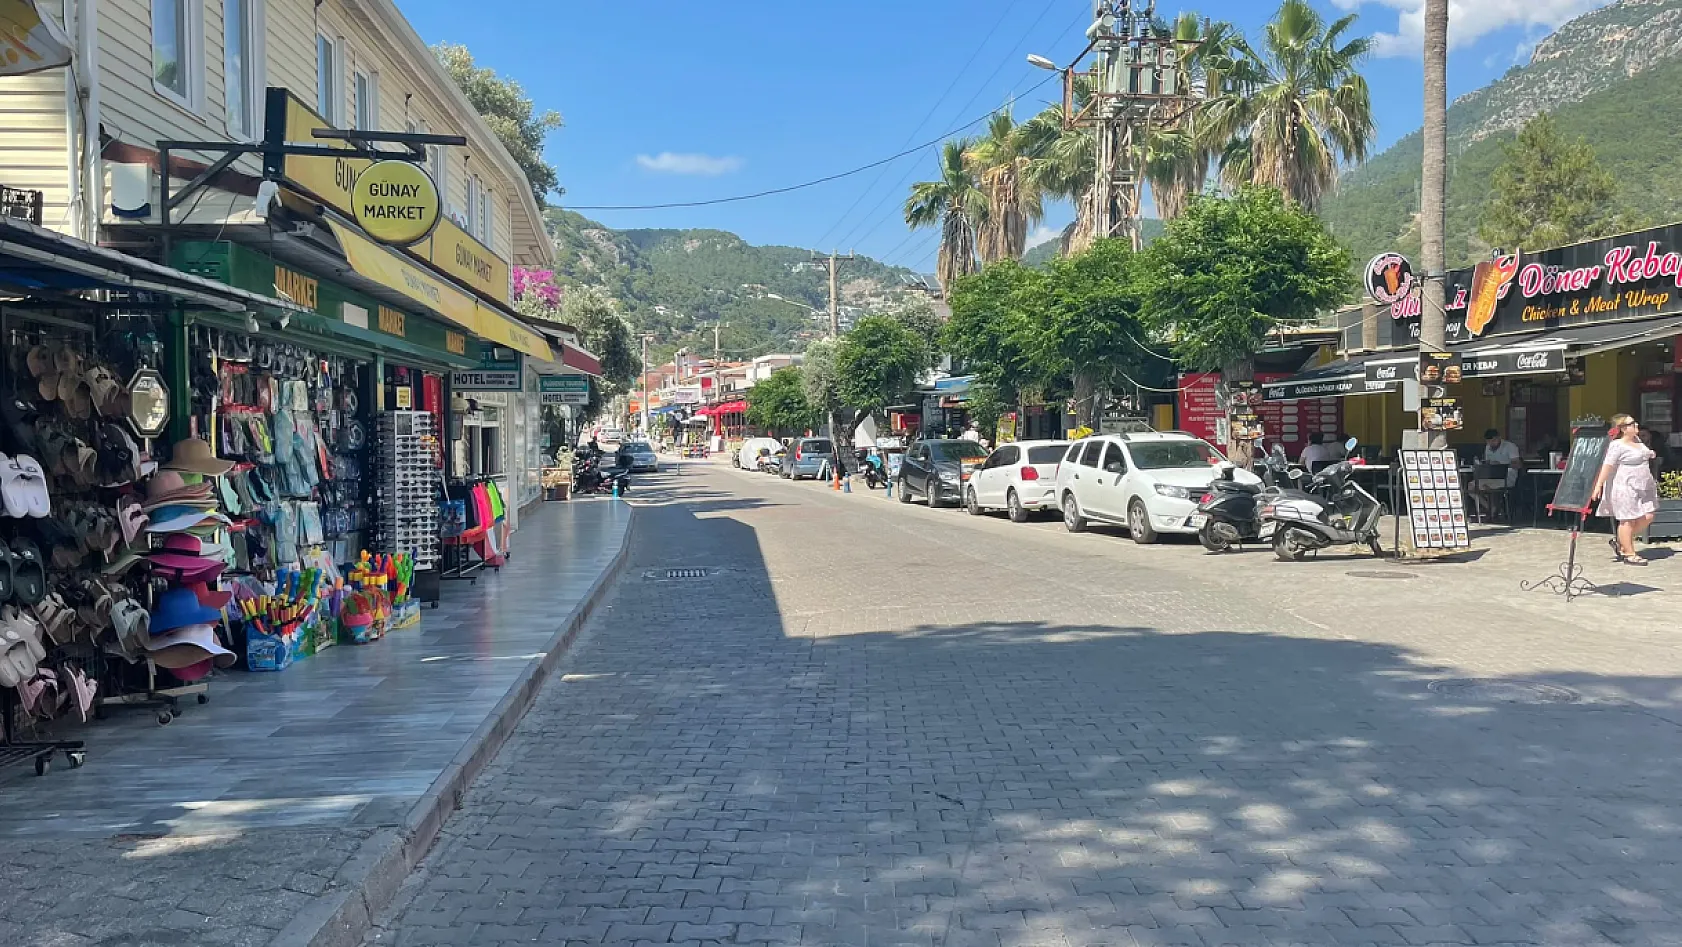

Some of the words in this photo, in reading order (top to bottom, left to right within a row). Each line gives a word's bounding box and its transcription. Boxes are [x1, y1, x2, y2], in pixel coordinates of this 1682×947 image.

[369, 179, 420, 198] GÜNAY
[364, 204, 426, 220] MARKET
[455, 239, 473, 272] GÜNAY
[473, 253, 493, 283] MARKET
[274, 265, 318, 310] MARKET
[1519, 263, 1601, 298] Döner
[1522, 304, 1566, 323] Chicken
[1570, 299, 1580, 316] &
[1584, 293, 1621, 314] Meat
[1625, 289, 1669, 311] Wrap
[378, 304, 406, 337] MARKET
[1473, 360, 1498, 371] KEBAP
[453, 373, 486, 386] HOTEL
[542, 394, 563, 403] HOTEL
